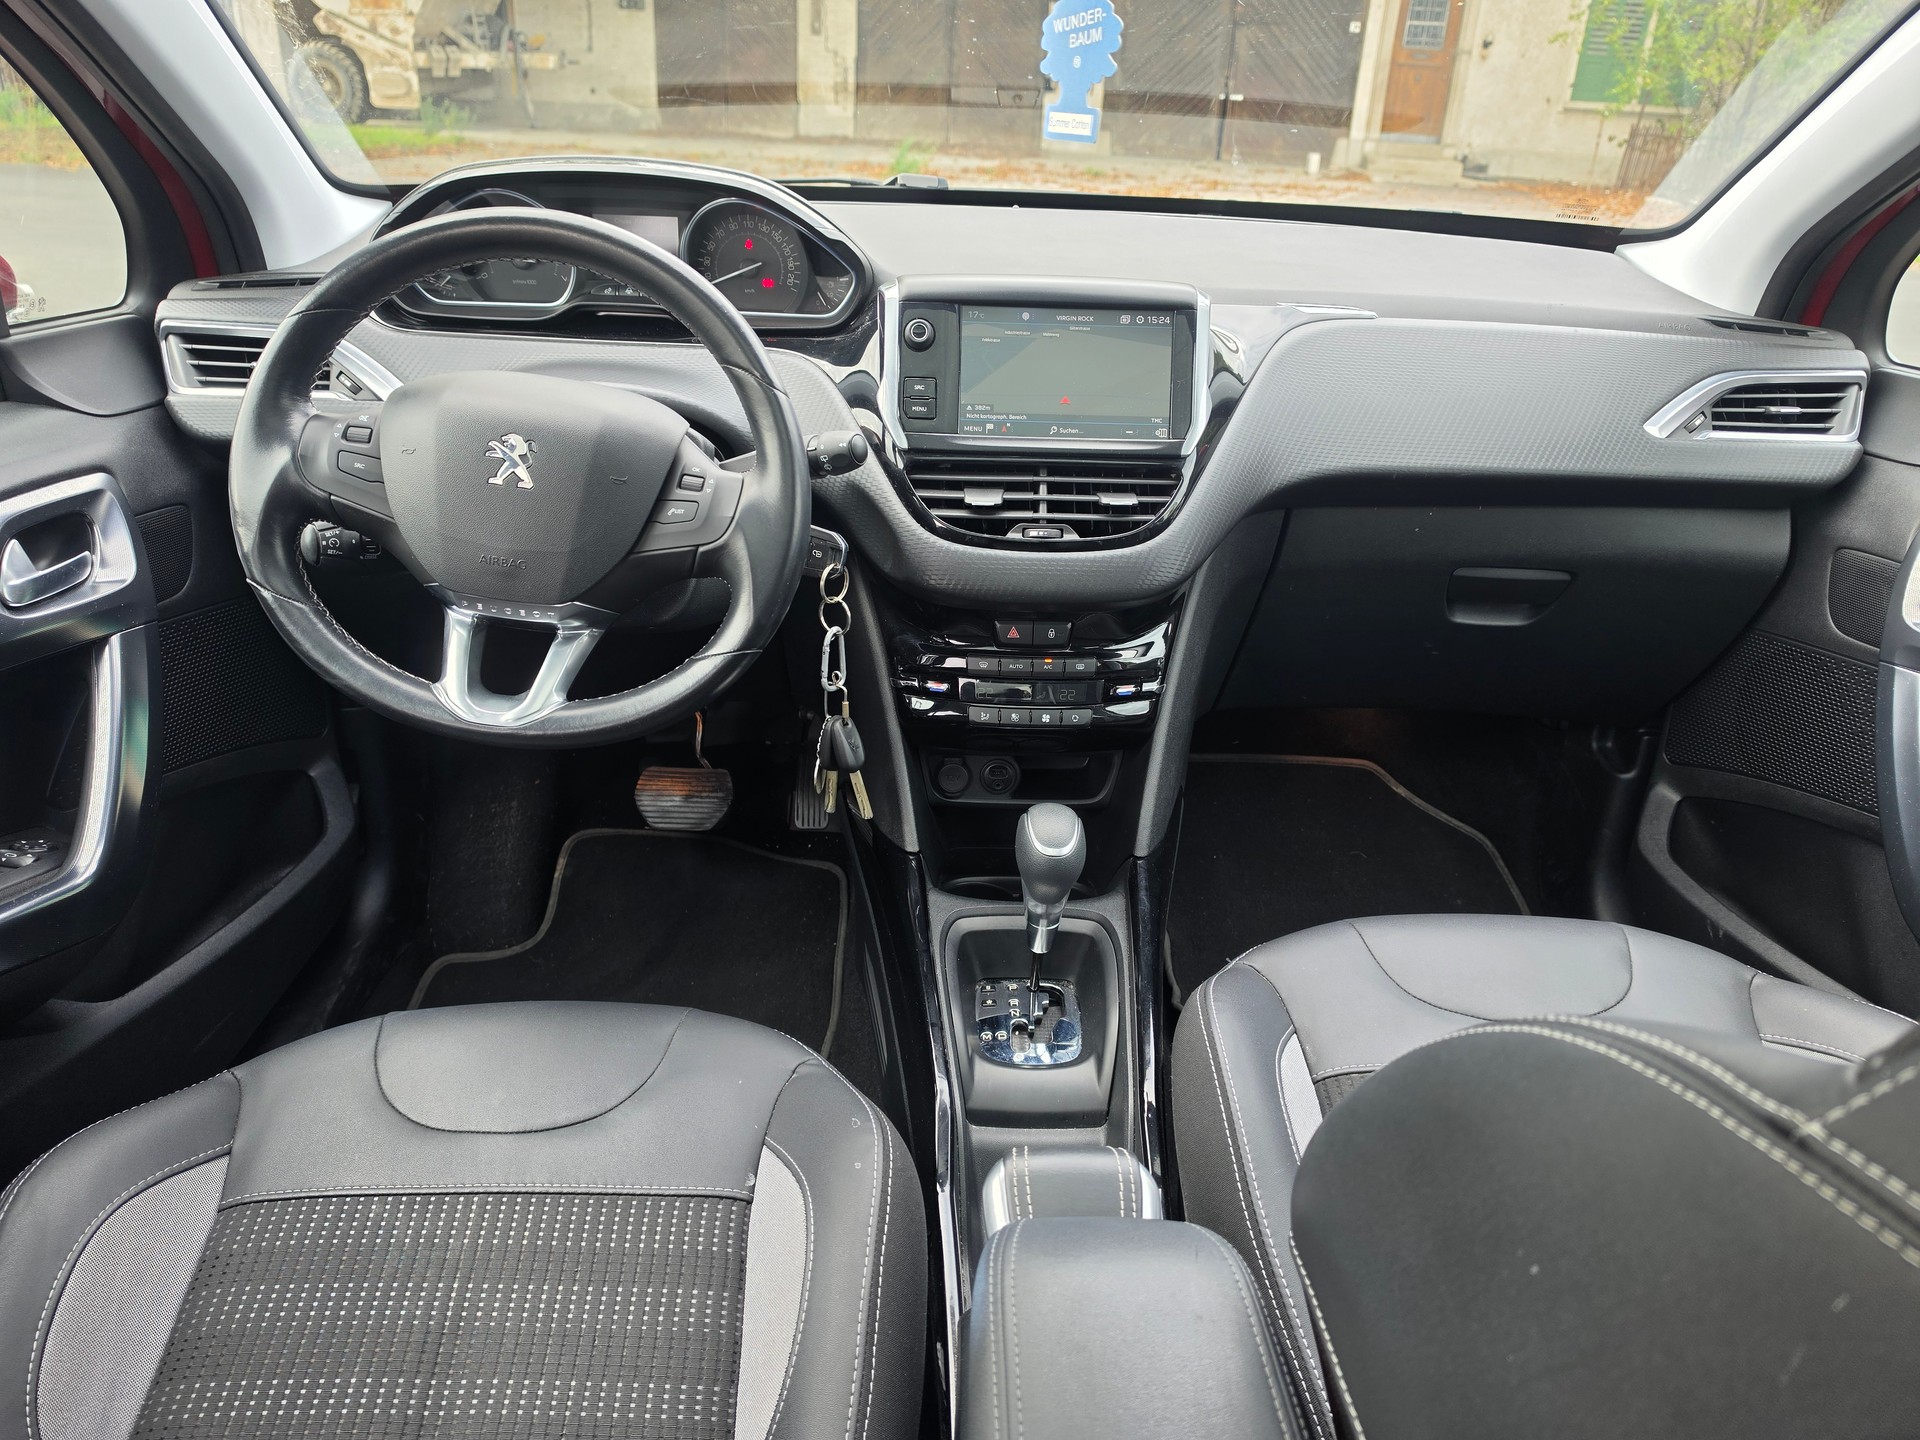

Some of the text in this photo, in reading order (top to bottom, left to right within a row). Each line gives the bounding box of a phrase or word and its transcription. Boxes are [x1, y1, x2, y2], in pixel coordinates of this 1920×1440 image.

[1053, 8, 1107, 34] WUNDER-
[1069, 27, 1103, 48] BAUM
[728, 222, 739, 231] 90
[743, 220, 755, 229] 110
[757, 222, 771, 234] 130
[715, 229, 726, 240] 70
[771, 230, 783, 244] 150
[707, 241, 716, 252] 50
[781, 243, 791, 257] 170
[703, 256, 711, 267] 30
[787, 257, 795, 271] 190
[786, 273, 795, 286] 210
[1147, 316, 1171, 324] 15:24
[478, 554, 527, 570] AIRBAG
[1060, 689, 1076, 701] 22
